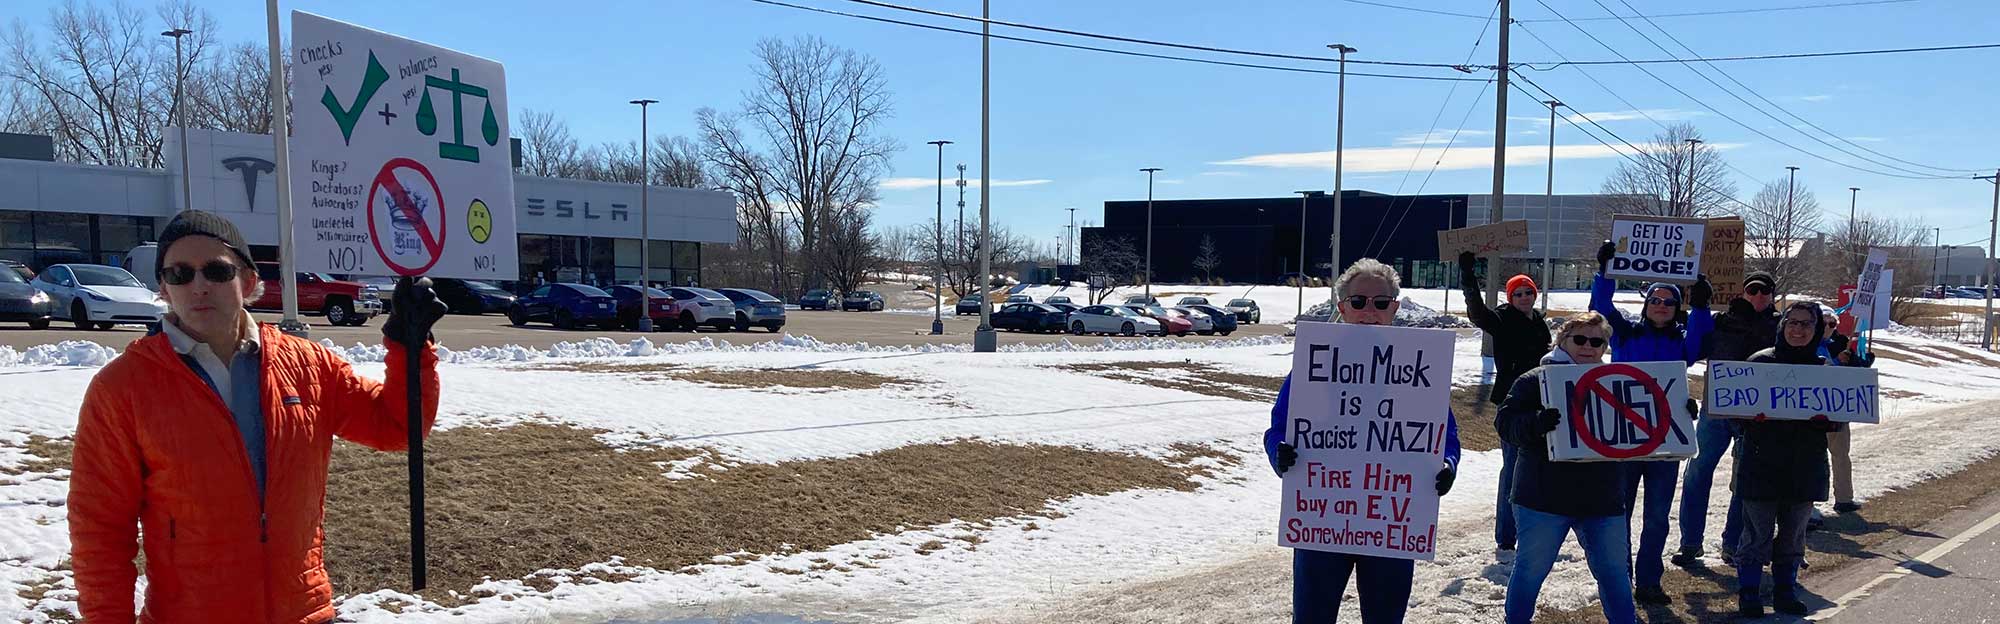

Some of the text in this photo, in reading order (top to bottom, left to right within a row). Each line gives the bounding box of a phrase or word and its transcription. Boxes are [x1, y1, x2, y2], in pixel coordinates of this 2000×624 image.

[300, 40, 343, 65] Checks
[399, 55, 438, 80] balances
[311, 159, 347, 181] Kings?
[312, 181, 363, 195] Dictators?
[312, 196, 359, 211] Autocrats?
[527, 198, 629, 222] ESLA
[312, 216, 354, 229] Unelected
[1632, 223, 1684, 241] GET US
[1712, 227, 1741, 241] ONLY
[1630, 240, 1683, 258] OUT OF
[1704, 240, 1743, 252] ORITY
[328, 246, 364, 272] NO!
[474, 254, 496, 272] NO!
[1612, 256, 1694, 275] DOGE!
[1308, 344, 1431, 388] Elon Musk
[1339, 391, 1394, 419] is a
[1715, 384, 1877, 418] BAD PRESIDENT
[1294, 418, 1445, 455] Racist NAZI!
[1363, 463, 1412, 493] Him
[1296, 490, 1411, 522] buy an E.V.
[1286, 518, 1436, 554] Somewhere Else!
